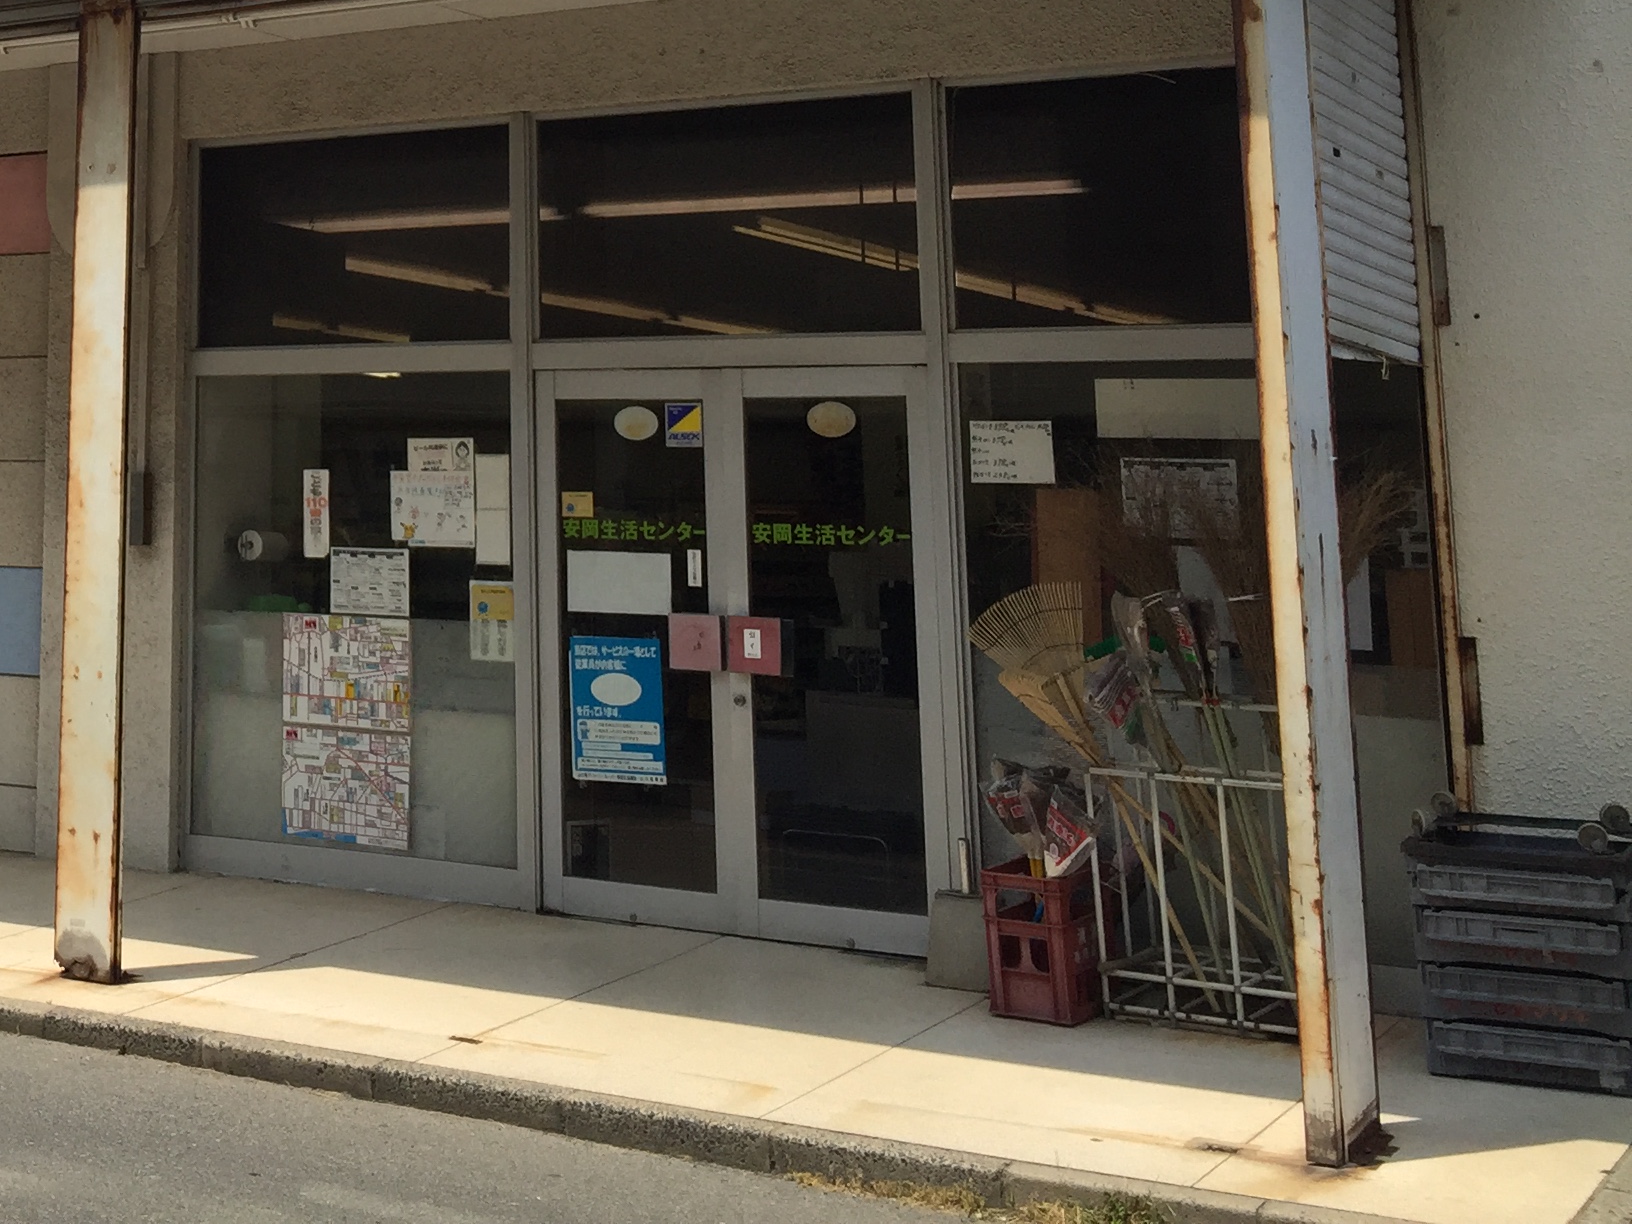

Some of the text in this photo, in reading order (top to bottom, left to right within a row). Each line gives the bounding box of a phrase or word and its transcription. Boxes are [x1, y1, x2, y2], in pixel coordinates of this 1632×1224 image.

[562, 518, 706, 542] 安岡生活センター
[752, 522, 910, 546] 安岡生活センター
